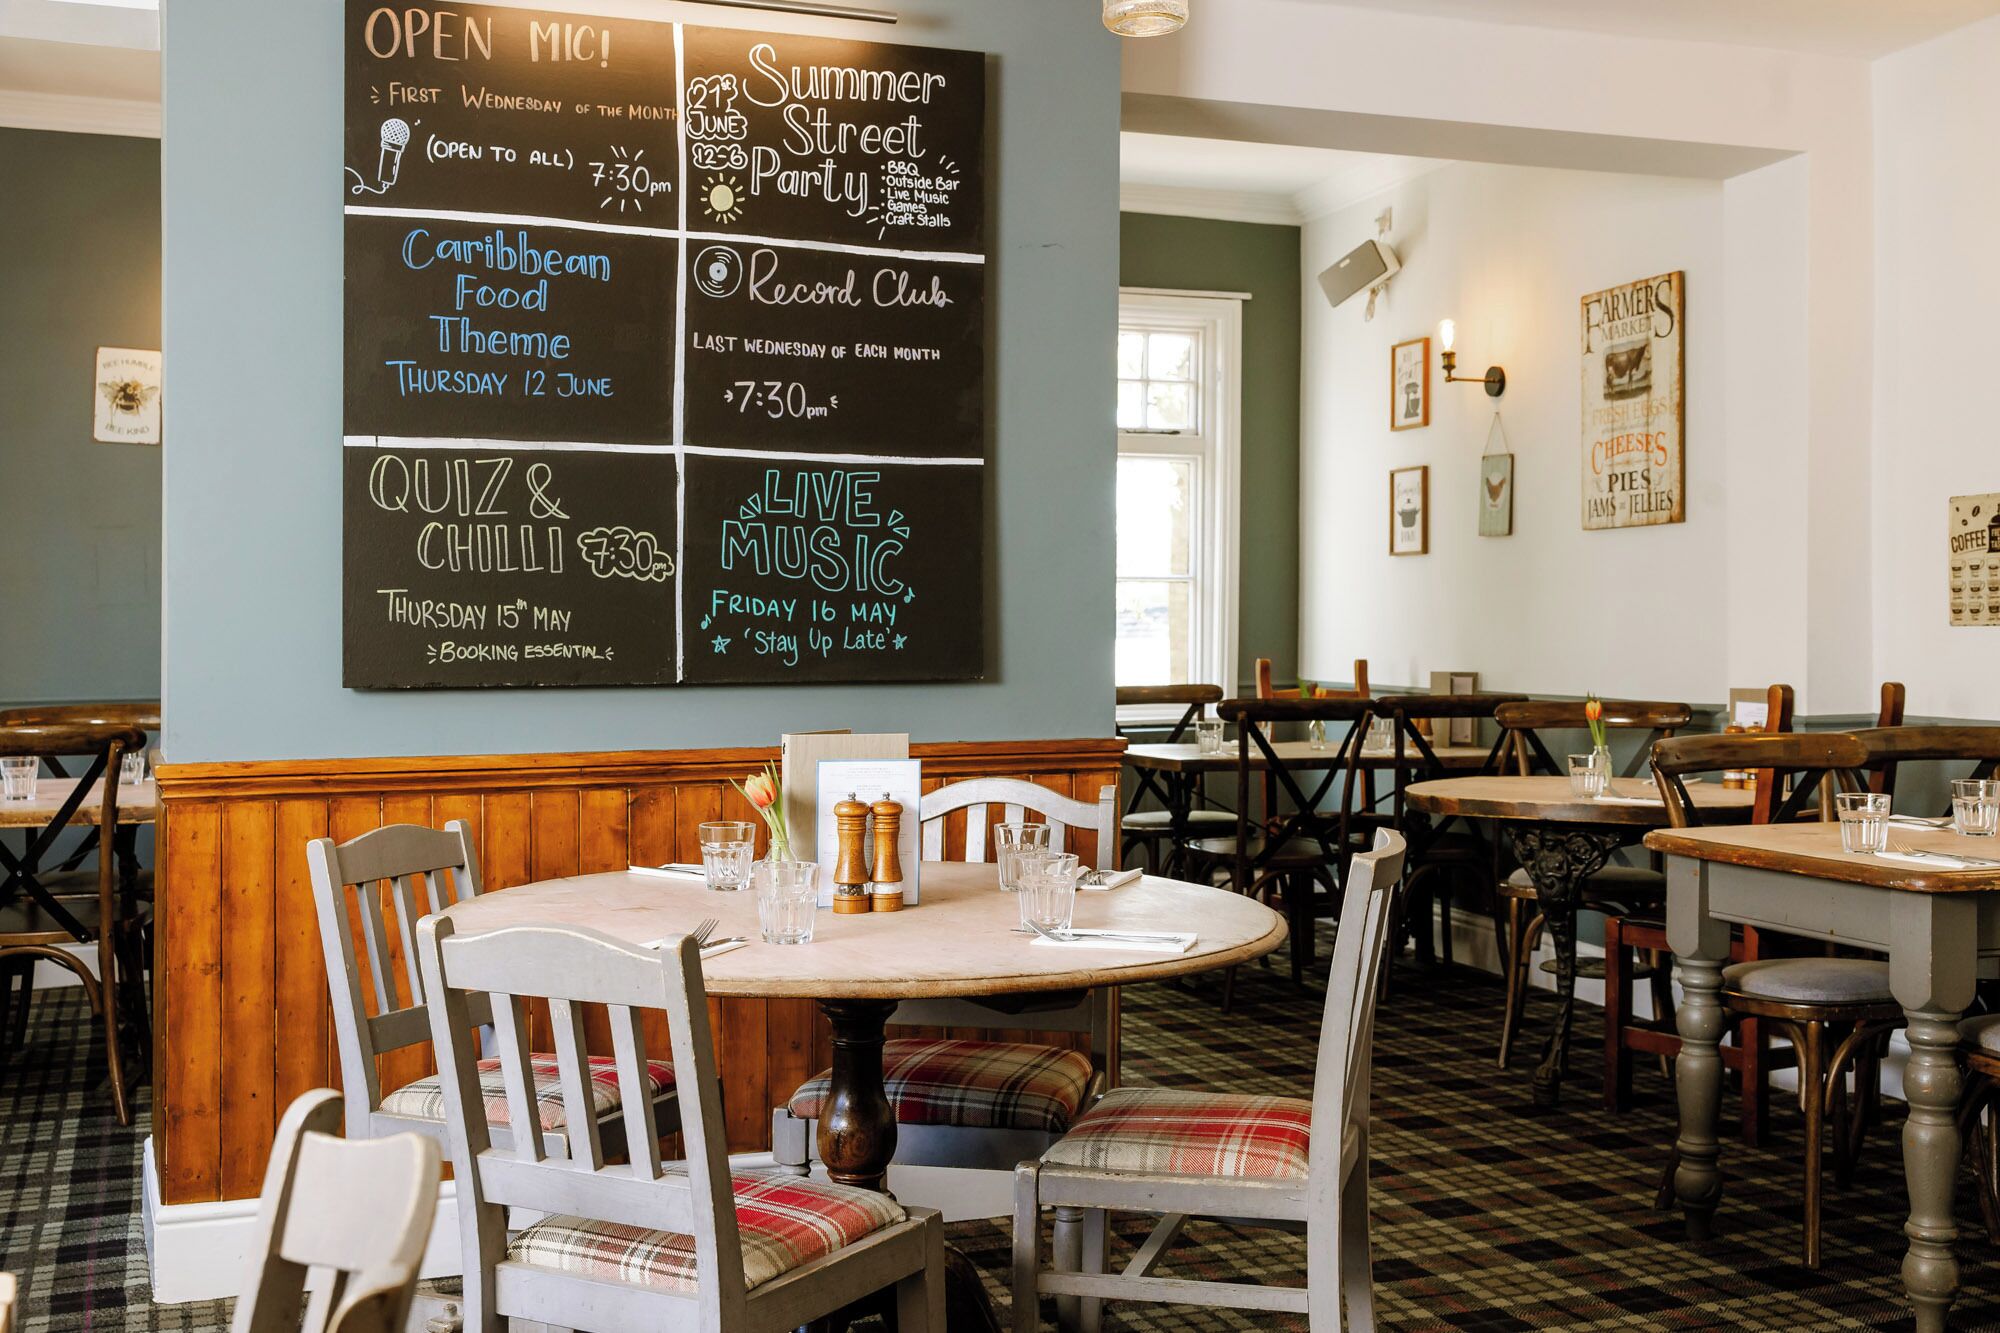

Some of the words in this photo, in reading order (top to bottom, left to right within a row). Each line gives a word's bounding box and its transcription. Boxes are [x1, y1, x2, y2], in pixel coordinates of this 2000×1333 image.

[365, 7, 492, 60] OPEN
[530, 20, 610, 68] MIC!
[743, 43, 947, 107] Summer
[389, 82, 442, 107] FIRST
[462, 85, 562, 114] WEDNESDAY
[575, 103, 591, 115] OF
[597, 105, 623, 118] THE
[628, 103, 680, 121] MONTH
[693, 79, 732, 110] 21st
[688, 110, 740, 137] JUNE
[783, 103, 926, 157] Street
[426, 134, 483, 164] (OPEN
[490, 146, 517, 163] TO
[529, 149, 574, 171] ALL)
[887, 160, 920, 177] BBQ
[751, 146, 868, 217] Party
[886, 175, 934, 190] Outside
[935, 176, 961, 191] Bar
[887, 187, 911, 201] Live
[914, 189, 950, 205] Music
[885, 211, 915, 226] Craft
[916, 213, 952, 228] Stalls
[887, 199, 927, 214] Games
[402, 229, 612, 282] Caribbean
[455, 273, 548, 312] Food
[749, 248, 862, 307] Record
[872, 267, 955, 308] Club
[1583, 275, 1674, 356] FARMERS
[429, 314, 571, 359] Theme
[692, 331, 738, 353] LAST
[744, 337, 827, 360] WEDNESDAY
[831, 345, 847, 360] OF
[854, 342, 888, 360] EACH
[893, 346, 941, 362] MONTH
[385, 360, 508, 398] THURSDAY
[524, 369, 546, 397] 12
[557, 372, 614, 398] JUNE
[1591, 431, 1668, 475] CHEESES
[369, 454, 514, 517] QUIZ
[526, 462, 570, 519] &
[765, 469, 881, 528] LIVE
[1607, 467, 1652, 494] PIES
[1587, 496, 1616, 521] JAMS
[1629, 488, 1674, 521] JELLIES
[417, 521, 564, 574] CHILLI
[721, 519, 905, 596] MUSIC
[1950, 528, 1988, 554] COFFEE
[376, 588, 487, 630] THURSDAY
[497, 597, 528, 630] 15th
[533, 605, 572, 633] MAY
[712, 589, 797, 622] FRIDAY
[812, 599, 837, 623] 16
[851, 602, 898, 626] MAY
[439, 641, 518, 663] BOOKING
[524, 643, 605, 661] ESSENTIAL
[809, 627, 833, 659] Up
